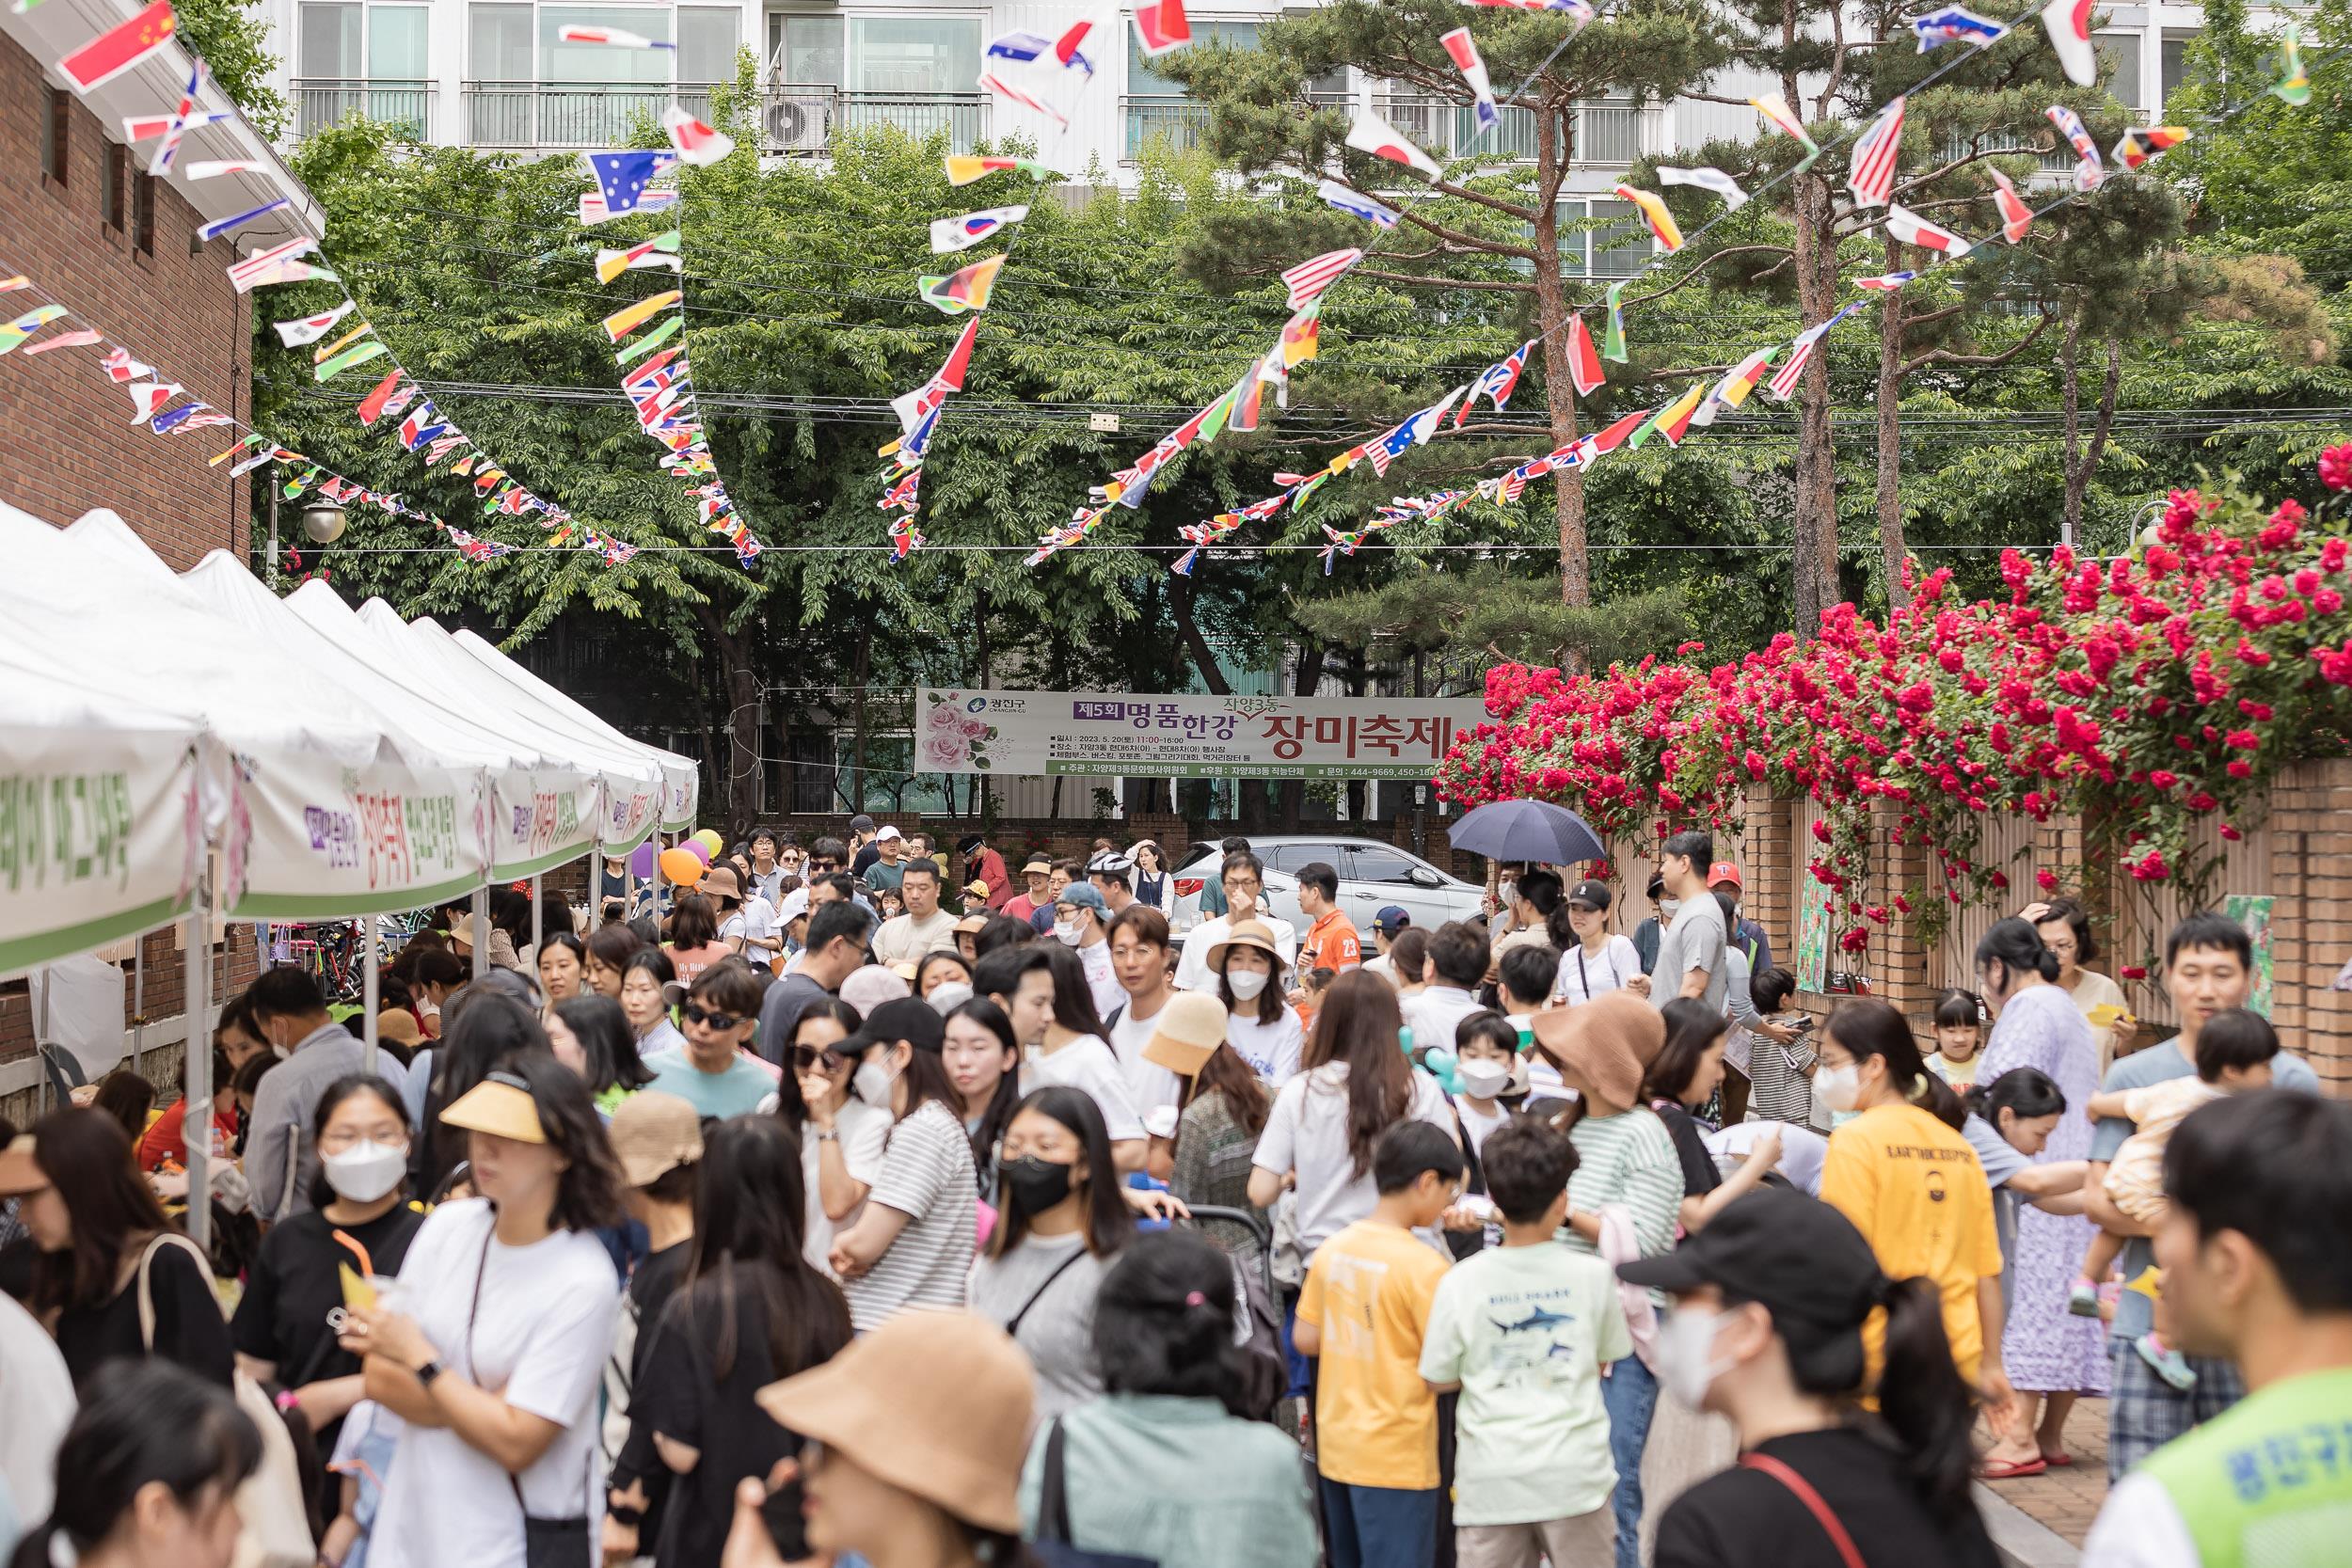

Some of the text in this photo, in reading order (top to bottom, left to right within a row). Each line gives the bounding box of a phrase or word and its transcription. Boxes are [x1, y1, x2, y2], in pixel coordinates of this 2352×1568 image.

[991, 699, 1025, 708] 광진구
[1224, 698, 1279, 712] 자양3동
[1078, 703, 1119, 719] 제5회
[1261, 714, 1452, 760] 장미축제
[1056, 735, 1073, 743] 일시
[1056, 743, 1073, 752] 장소
[1078, 744, 1107, 752] 자양3동
[1109, 744, 1151, 752] 현대6차(아)
[1158, 745, 1200, 753] 현대8차(아)
[1069, 764, 1085, 773] 주관
[1091, 764, 1188, 775] 자양제3동문화행사위원회
[1206, 766, 1223, 775] 후원
[1231, 766, 1270, 776] 자양제3동
[1271, 767, 1305, 776] 직능단체
[1327, 767, 1343, 776] 문의
[1343, 938, 1358, 958] 23
[678, 962, 689, 974] My
